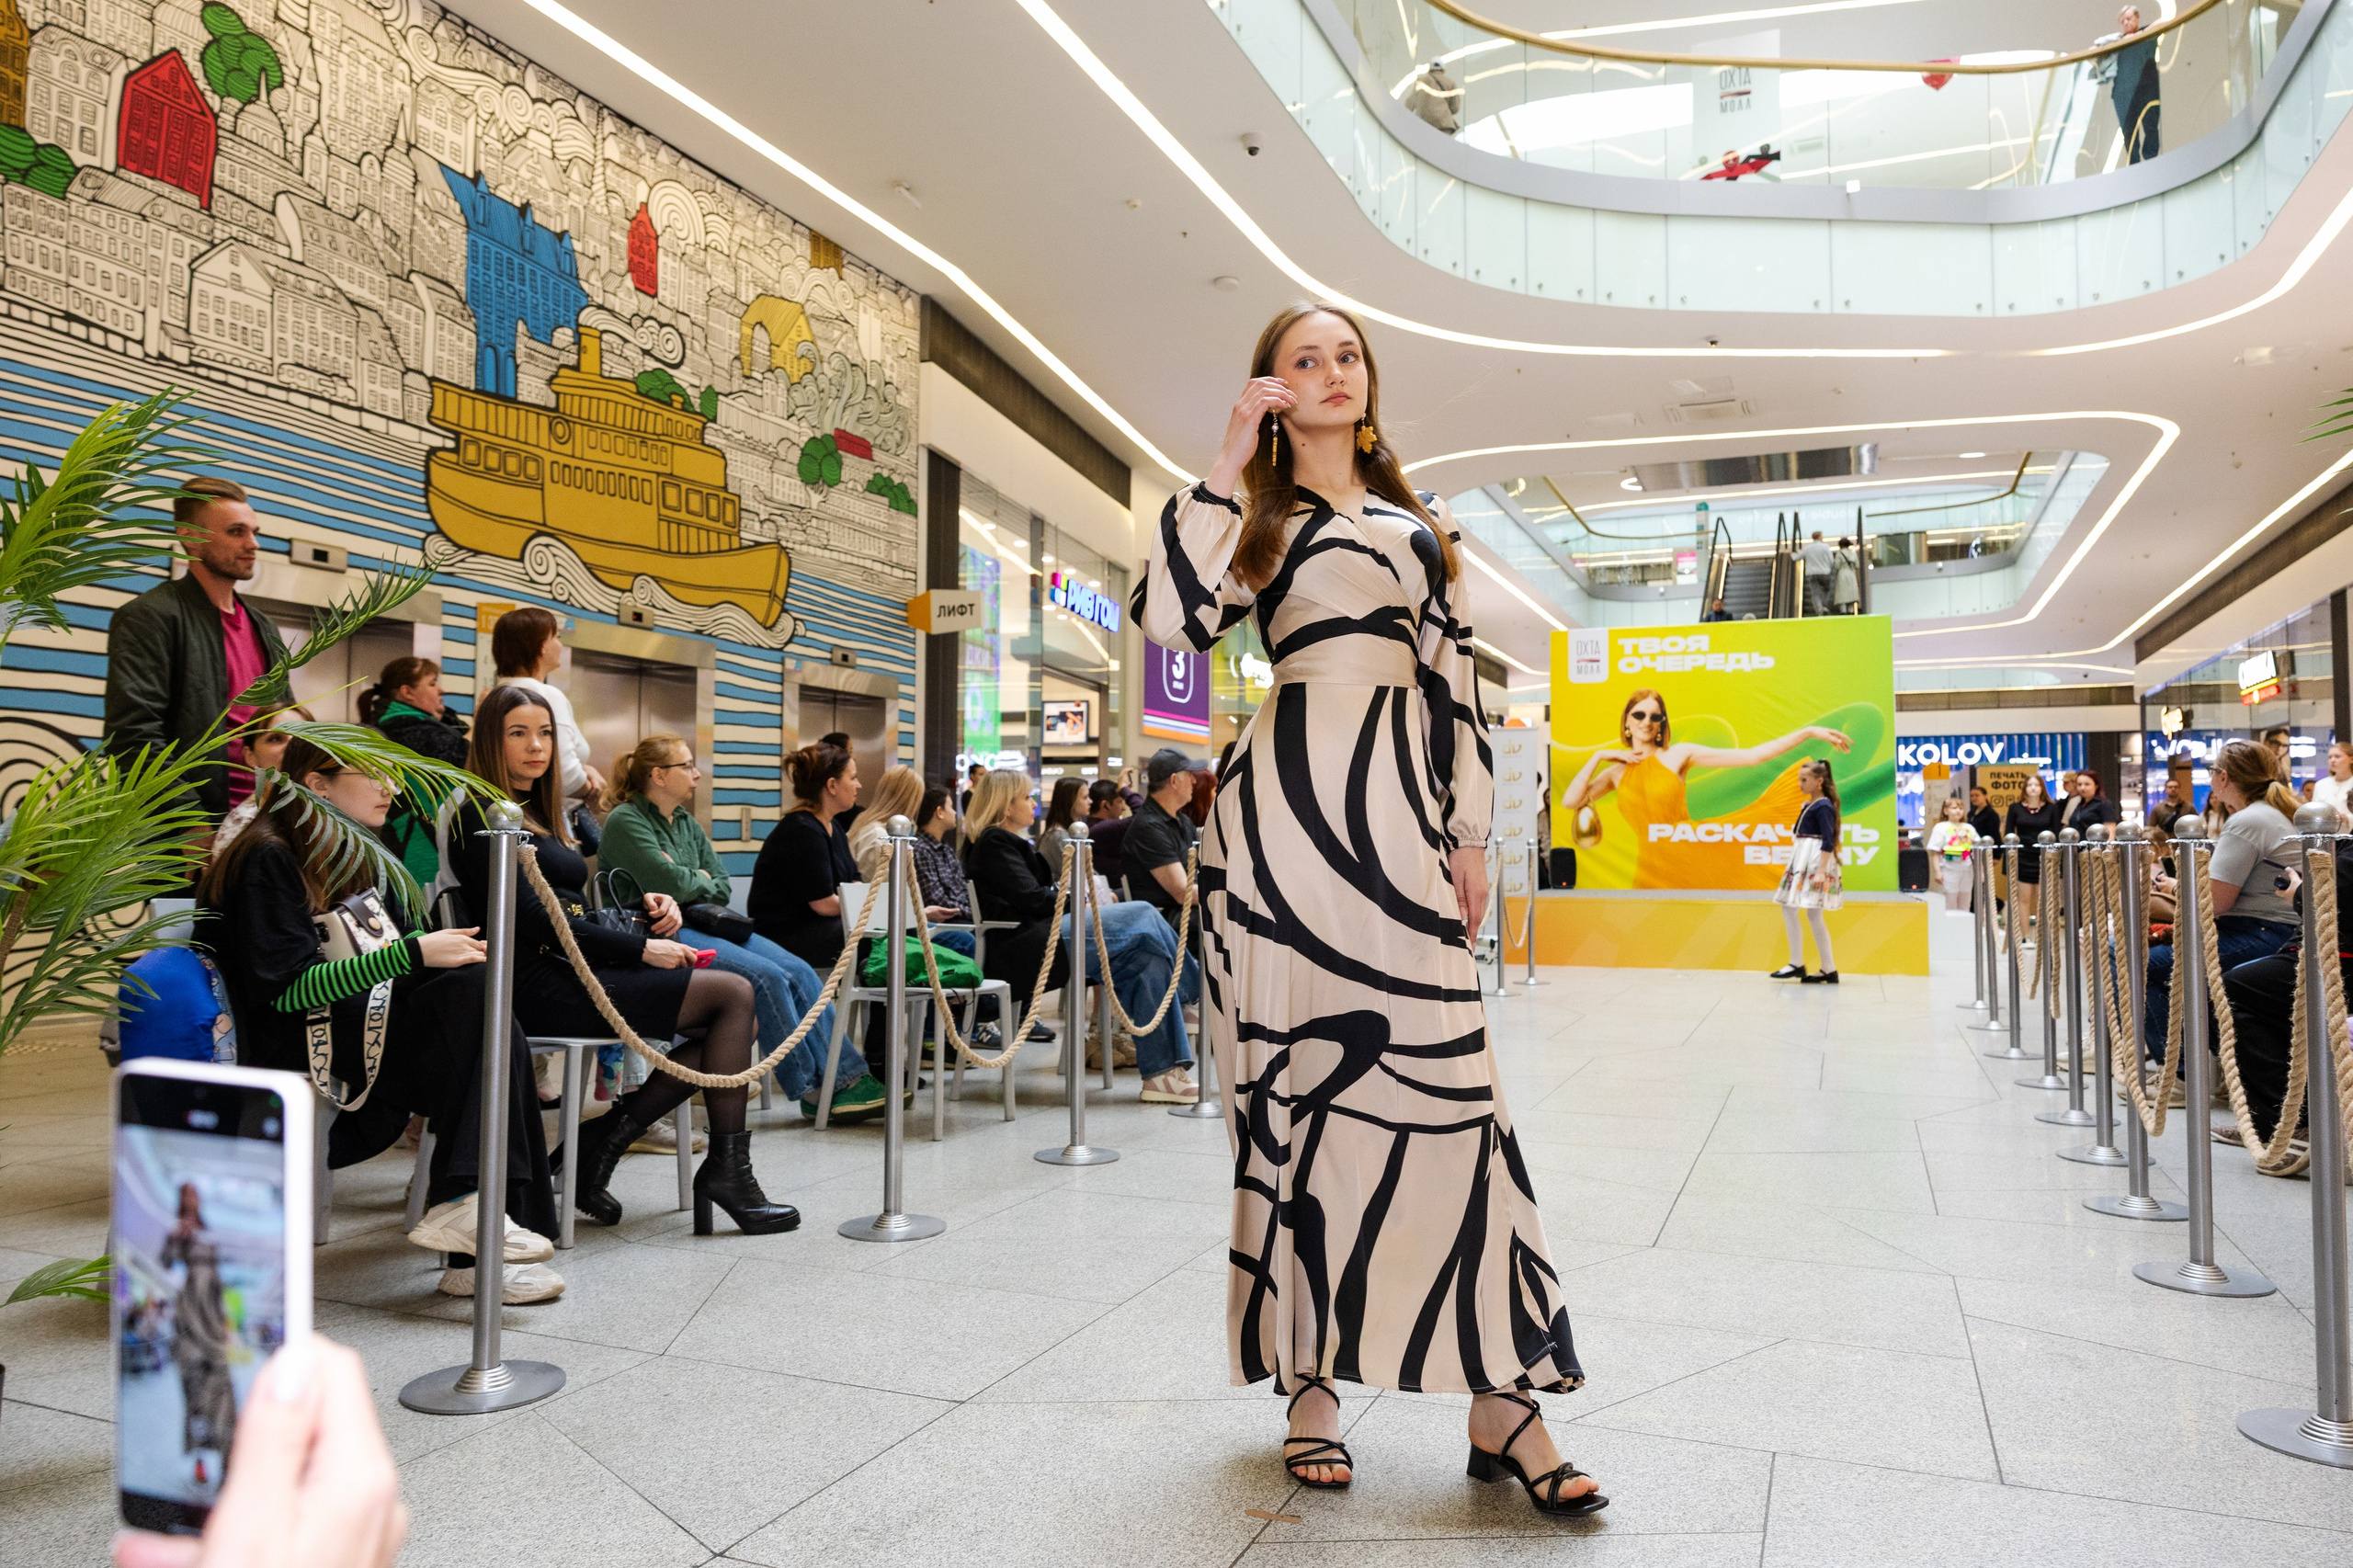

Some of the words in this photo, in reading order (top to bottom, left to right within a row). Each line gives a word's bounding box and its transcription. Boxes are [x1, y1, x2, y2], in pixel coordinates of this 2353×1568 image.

[937, 603, 975, 618] ЛИФТ
[1576, 640, 1600, 656] ОХТА
[1617, 634, 1710, 655] ТВОЯ
[1576, 665, 1600, 676] МОЛЛ
[1617, 652, 1776, 674] ОЧЕРЕДЬ
[1648, 823, 1881, 843] РАСКАЧТЬ
